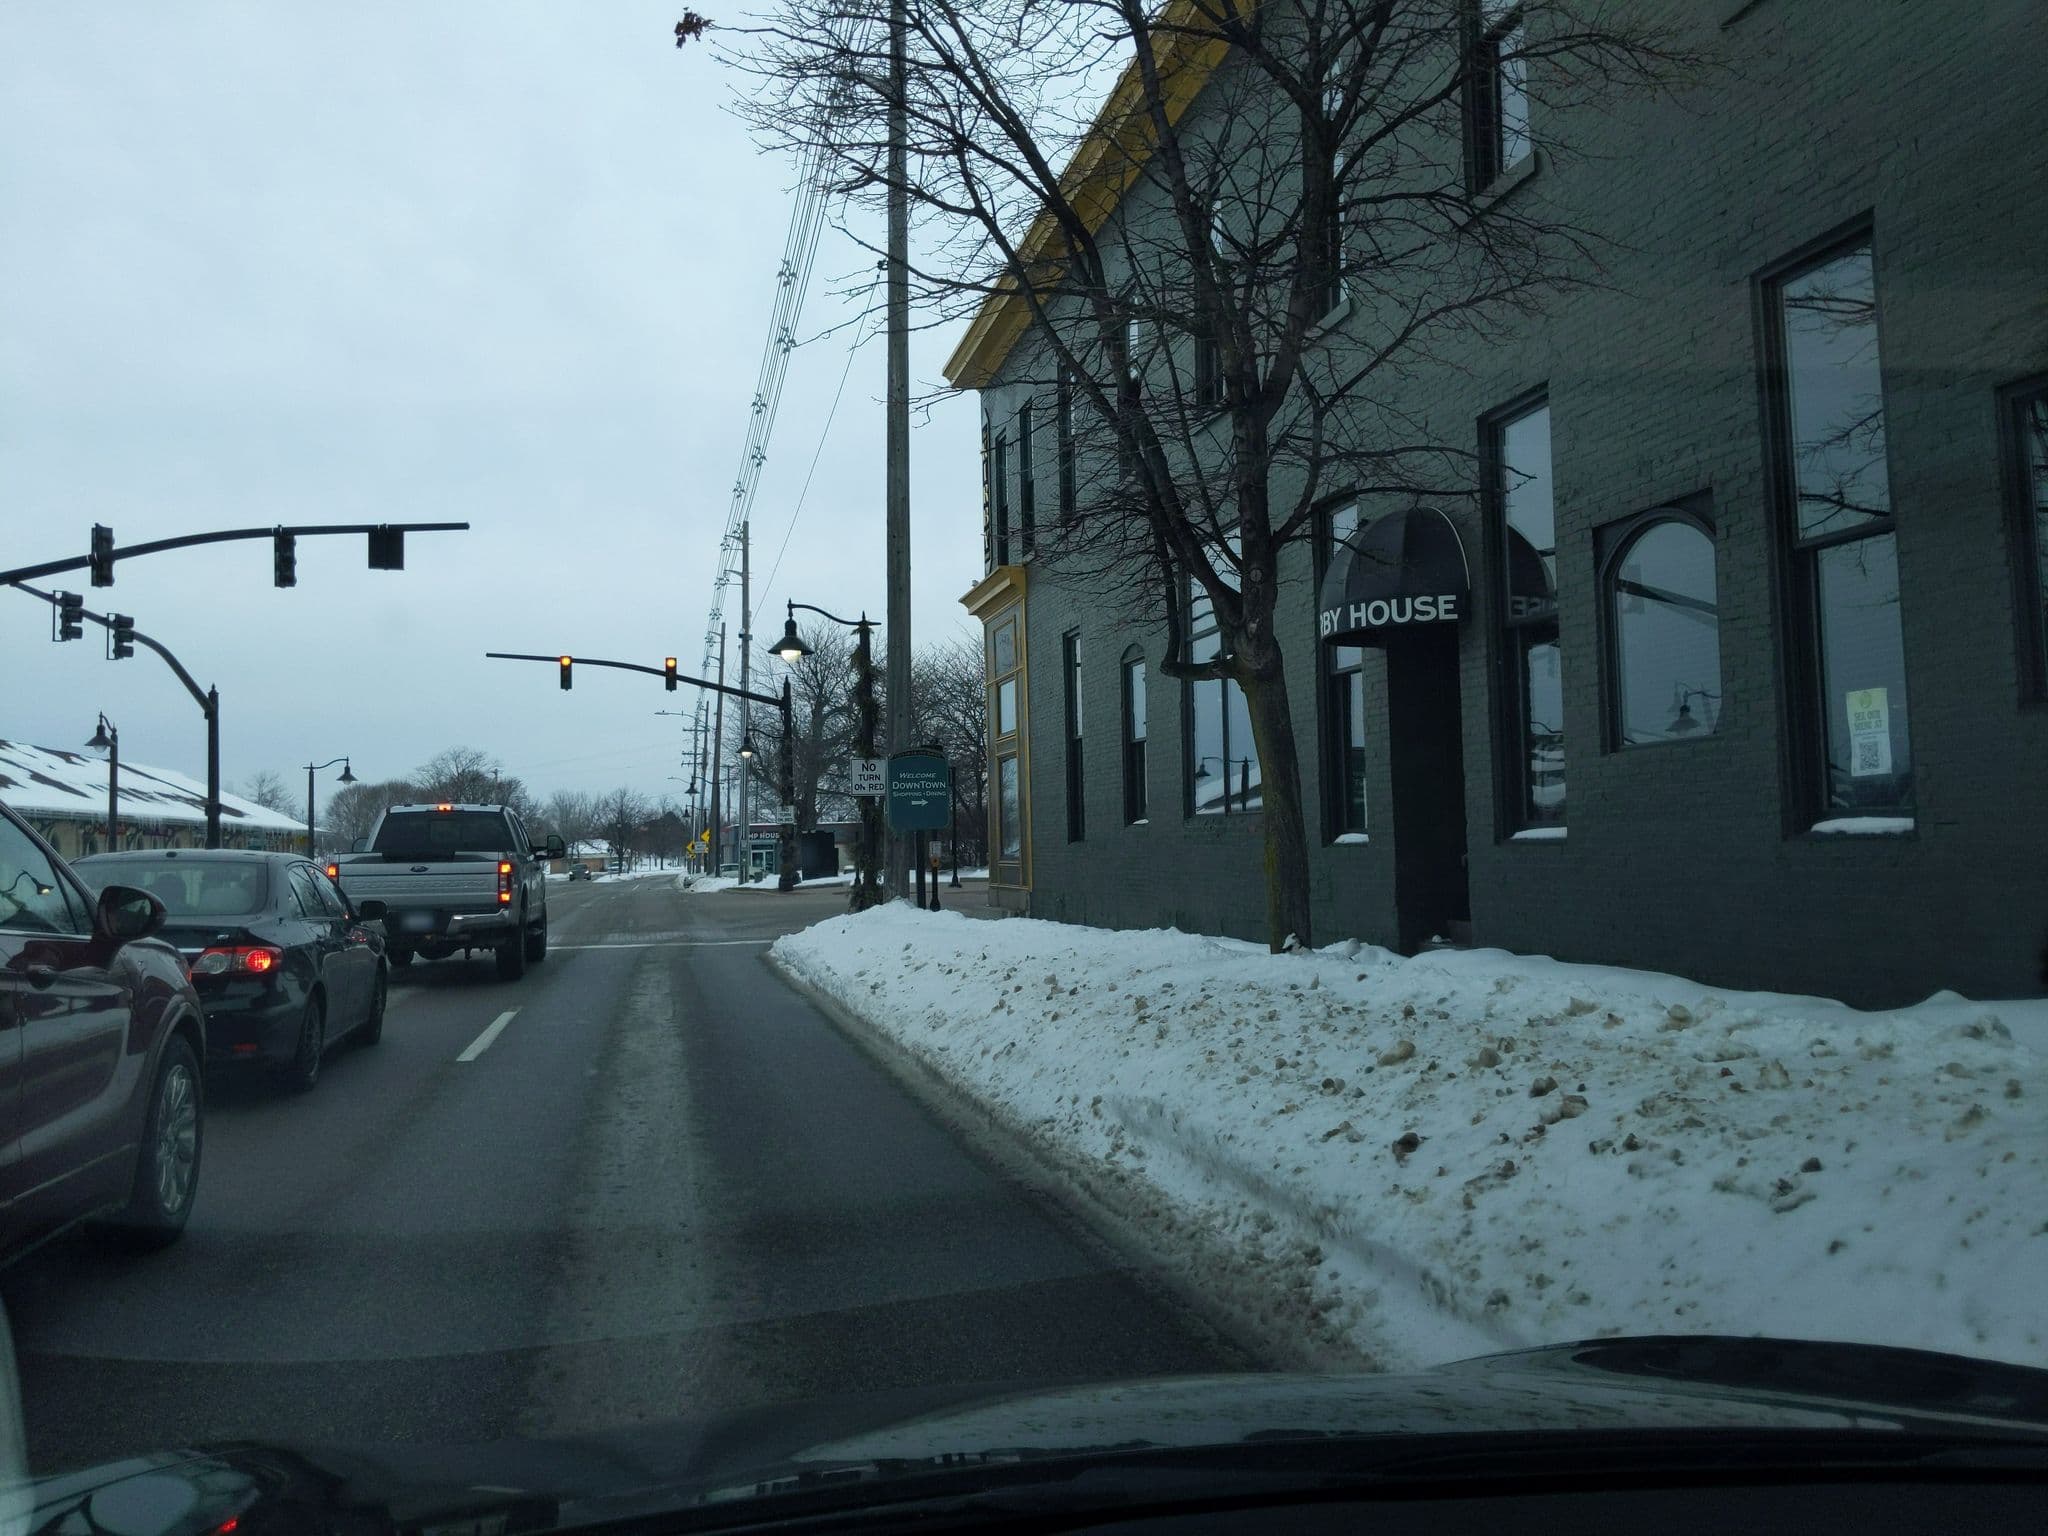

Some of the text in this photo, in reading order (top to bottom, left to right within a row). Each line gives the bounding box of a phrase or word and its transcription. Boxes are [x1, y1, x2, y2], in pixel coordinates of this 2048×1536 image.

[1349, 594, 1459, 629] HOUSE
[861, 763, 877, 772] NO
[868, 783, 885, 791] RED
